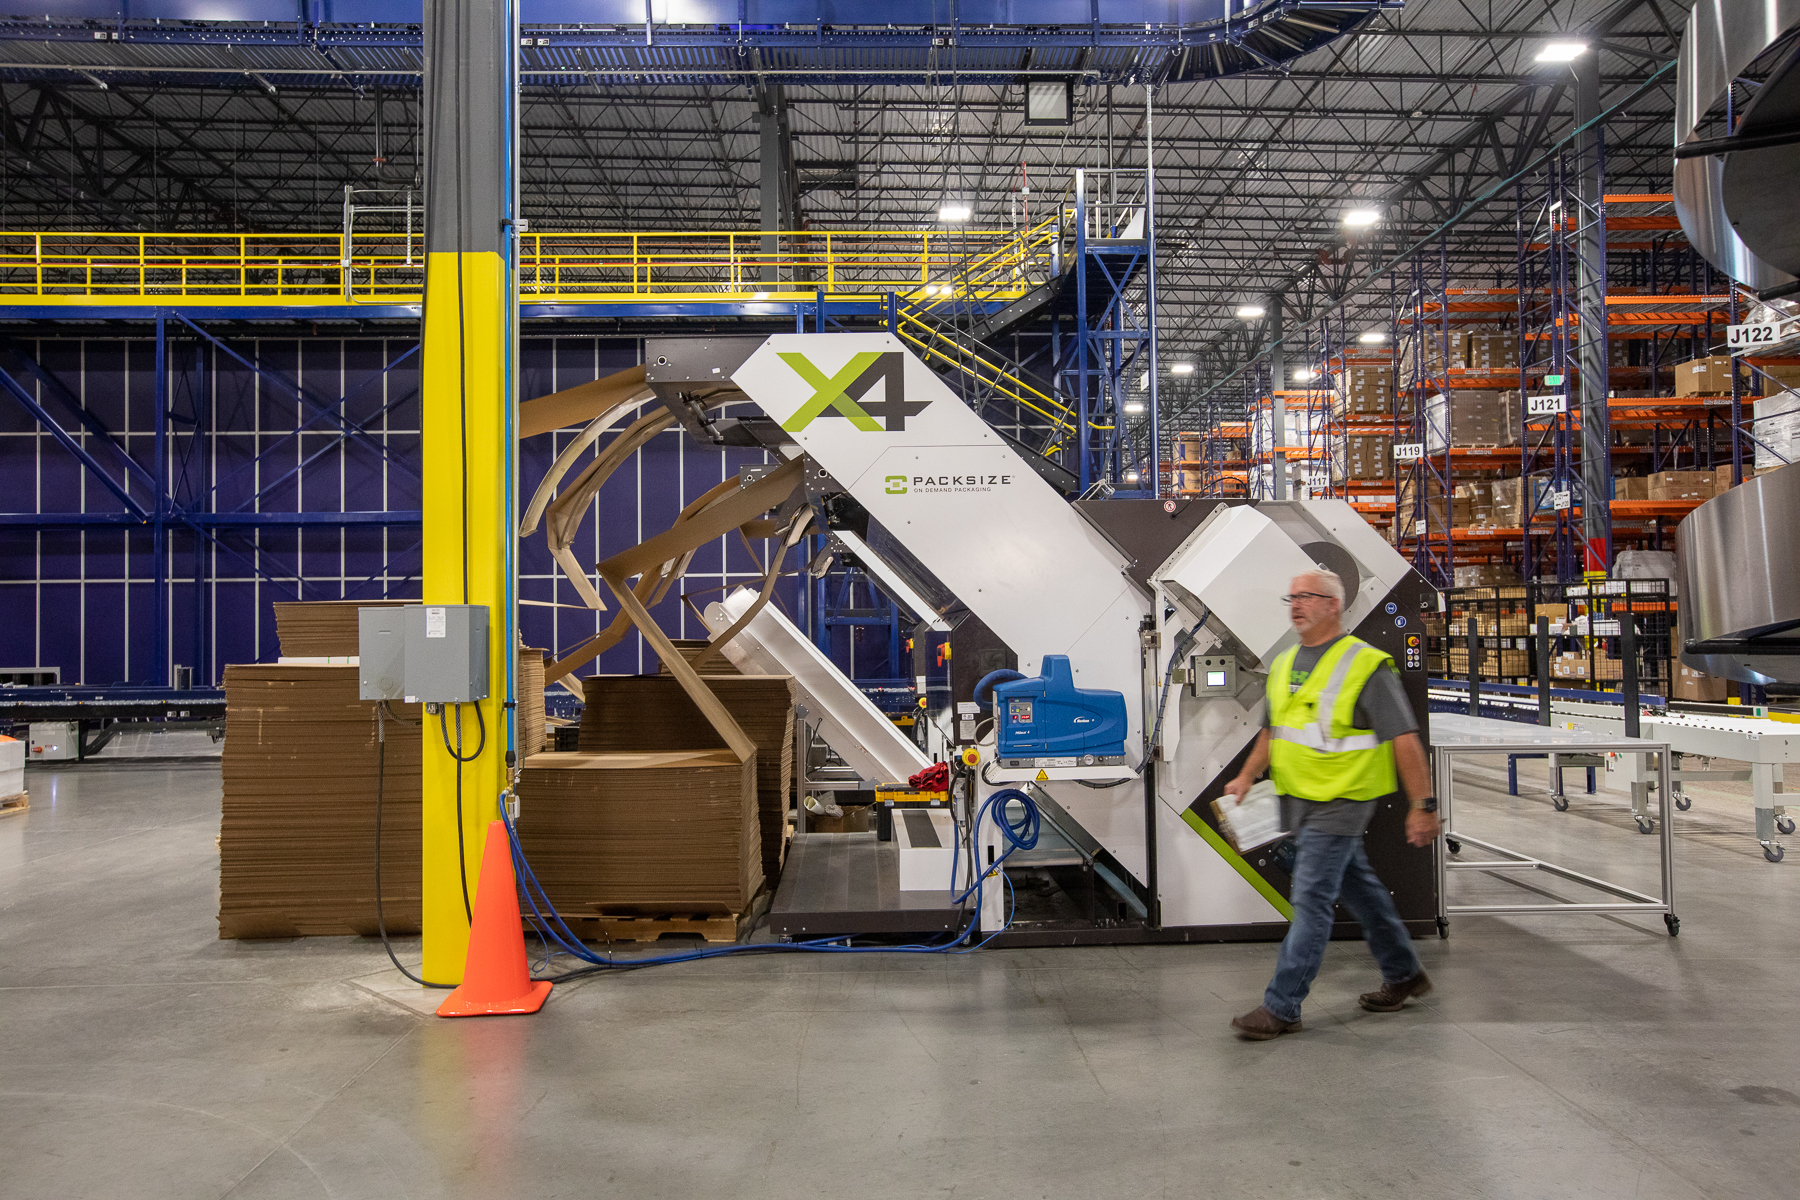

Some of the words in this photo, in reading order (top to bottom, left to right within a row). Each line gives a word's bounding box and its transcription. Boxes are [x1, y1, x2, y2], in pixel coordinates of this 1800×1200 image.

[1731, 326, 1773, 344] J122
[775, 352, 933, 432] X4
[1531, 398, 1561, 411] J121
[1396, 446, 1420, 457] J119
[913, 475, 1011, 485] PACKSIZE
[1307, 478, 1327, 486] J117
